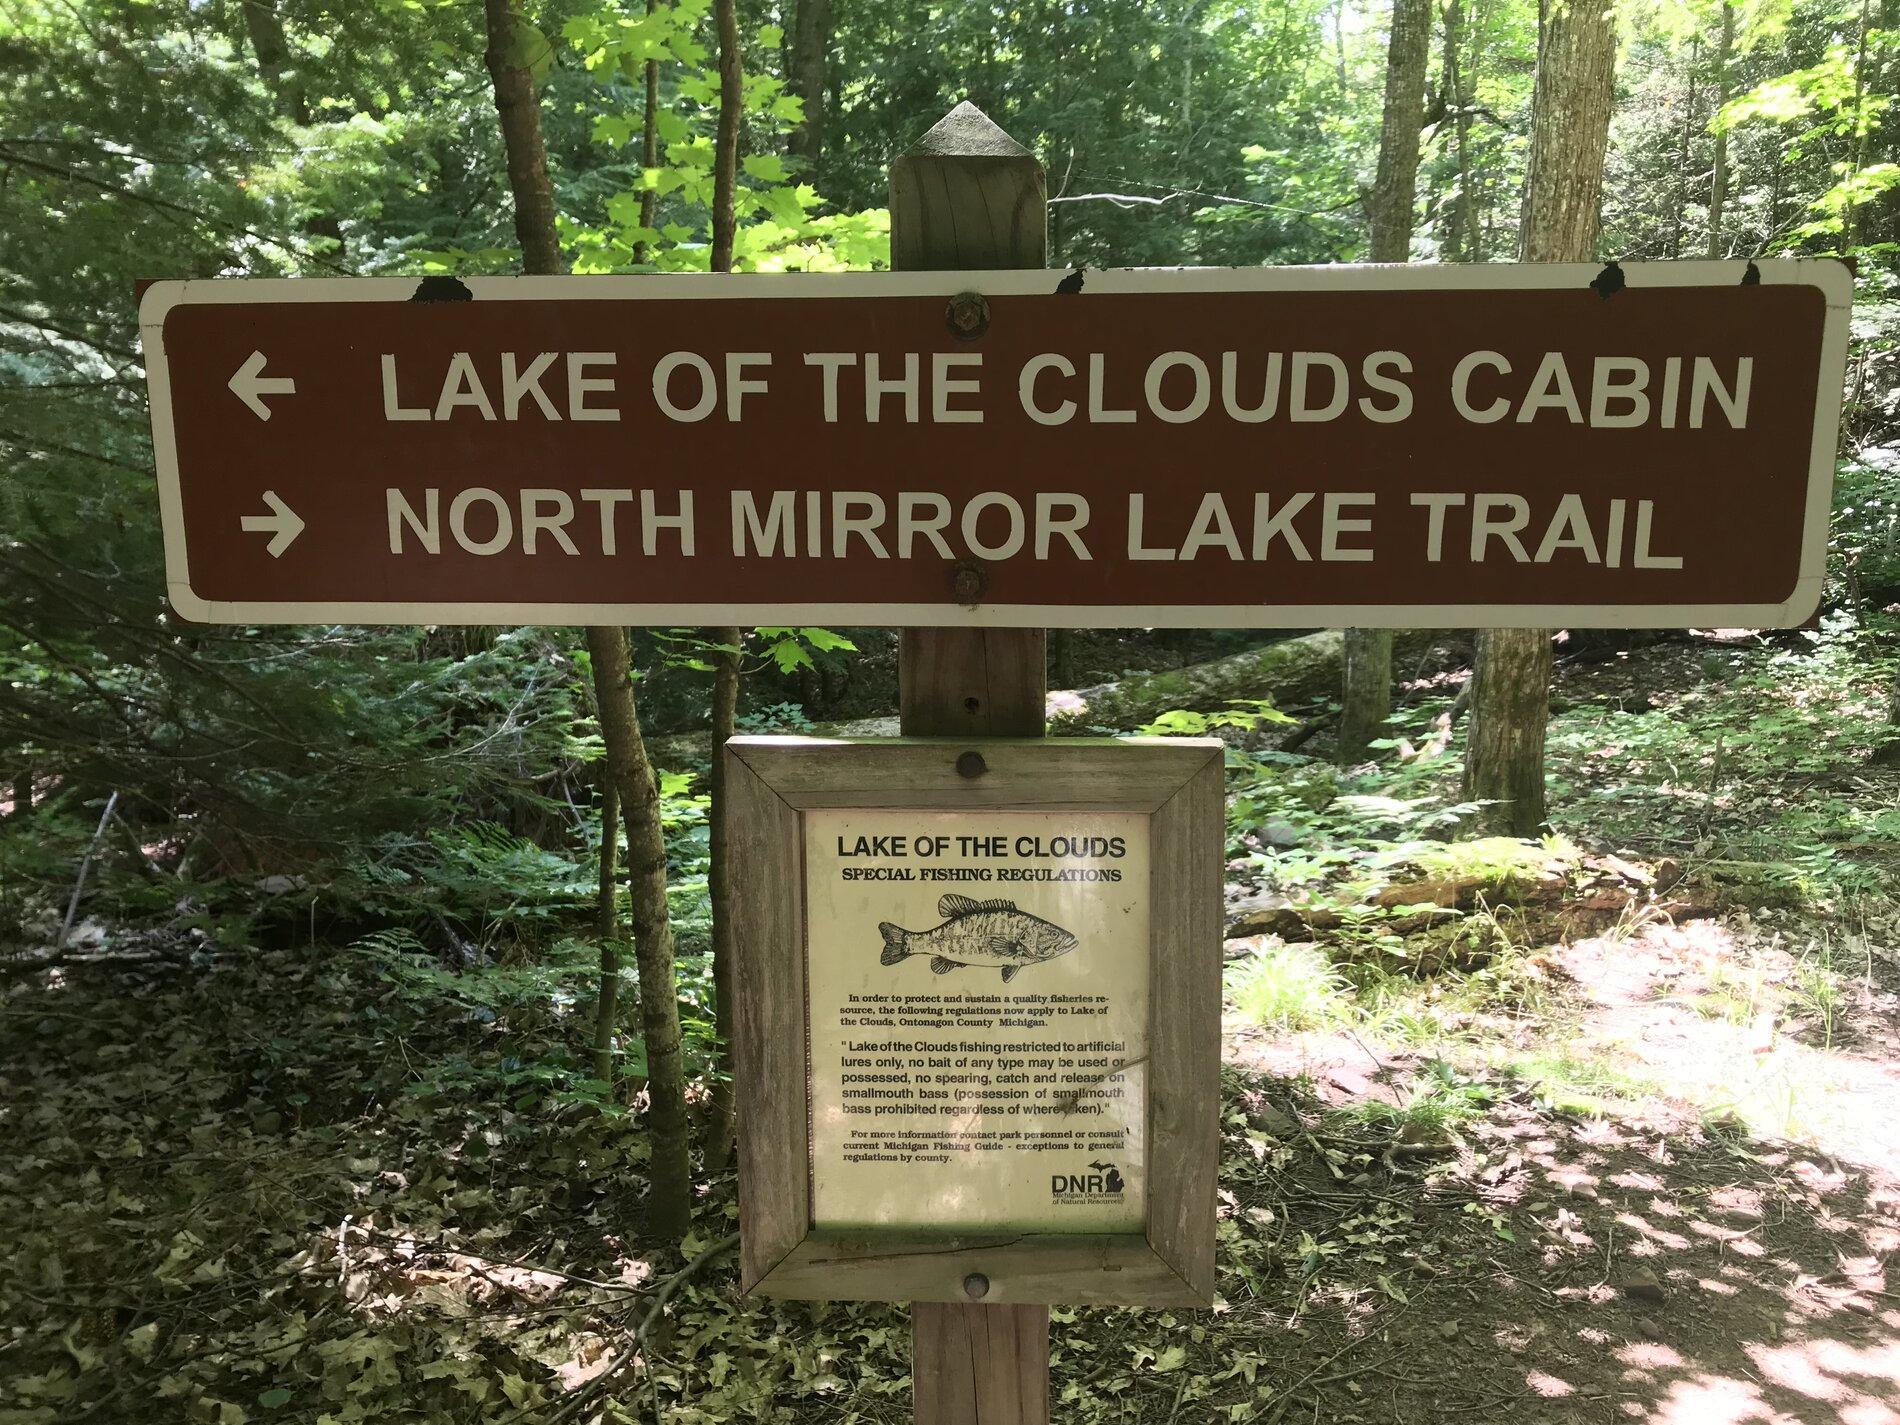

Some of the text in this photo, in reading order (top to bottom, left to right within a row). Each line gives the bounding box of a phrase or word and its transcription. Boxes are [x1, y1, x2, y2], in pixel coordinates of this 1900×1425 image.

[382, 351, 1753, 429] LAKE OF THE CLOUDS CABIN
[386, 488, 1684, 569] NORTH MIRROR LAKE TRAIL
[838, 836, 1127, 858] LAKE OF THE CLOUDS
[842, 868, 1122, 882] SPECIAL FISHING REGULATIONS
[849, 994, 859, 1003] In
[862, 994, 889, 1003] order
[891, 995, 902, 1003] to
[905, 995, 941, 1005] protect
[944, 994, 962, 1003] and
[965, 994, 1001, 1003] sustain
[1013, 994, 1048, 1005] quality
[1050, 994, 1093, 1003] fisheries
[840, 1007, 876, 1015] source,
[878, 1006, 895, 1015] the
[898, 1006, 944, 1017] following
[946, 1006, 1001, 1017] regulations
[1027, 1007, 1055, 1017] apply
[1057, 1007, 1068, 1015] to
[1071, 1006, 1095, 1015] Lake
[1097, 1006, 1109, 1015] of
[840, 1018, 1049, 1028] the Clouds, Ontonagon County Michigan.
[849, 1041, 879, 1052] Lake
[880, 1041, 892, 1052] of
[893, 1041, 913, 1052] the
[914, 1041, 958, 1052] Clouds
[960, 1041, 1002, 1055] fishing
[1003, 1041, 1061, 1052] restricted
[1063, 1042, 1075, 1052] to
[1076, 1041, 1126, 1052] artificial
[842, 1056, 1126, 1070] lures only, no bait of any type may be used or
[841, 1072, 1125, 1086] possessed, no spearing, catch and release on
[842, 1088, 1125, 1102] smallmouth bass (possession of smallmouth
[842, 1103, 871, 1115] bass
[875, 1104, 937, 1117] prohibited
[940, 1104, 1004, 1117] regardless
[1007, 1104, 1020, 1115] of
[1023, 1104, 1060, 1114] where
[850, 1130, 869, 1139] For
[898, 1130, 957, 1139] information
[960, 1130, 998, 1139] contact
[999, 1130, 1021, 1141] park
[1024, 1130, 1074, 1141] personnel
[1088, 1129, 1125, 1138] consult
[843, 1142, 880, 1150] current
[883, 1142, 930, 1152] Michigan
[933, 1142, 971, 1152] Fishing
[974, 1142, 1004, 1150] Guide
[1016, 1142, 1070, 1152] exceptions
[1074, 1142, 1085, 1150] to
[1088, 1141, 1125, 1151] general
[843, 1153, 952, 1164] regulations by county.
[1051, 1175, 1104, 1193] DNR
